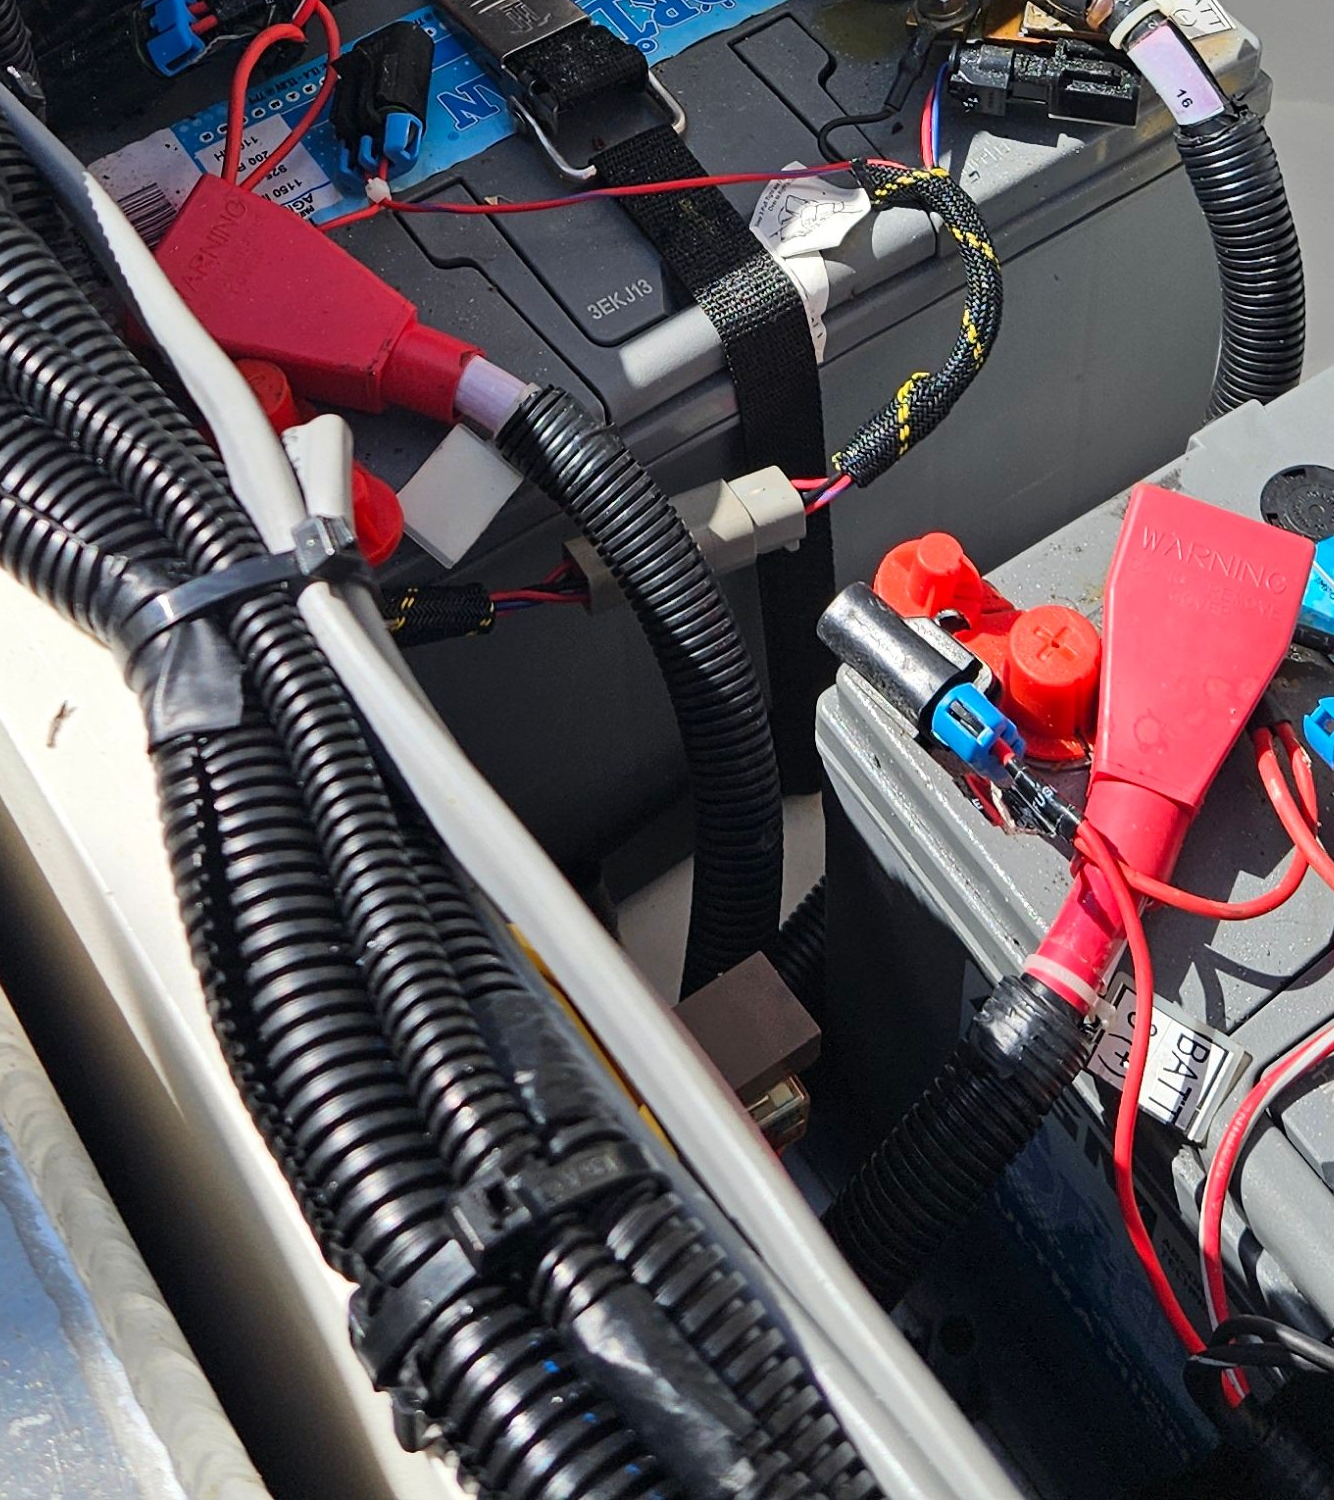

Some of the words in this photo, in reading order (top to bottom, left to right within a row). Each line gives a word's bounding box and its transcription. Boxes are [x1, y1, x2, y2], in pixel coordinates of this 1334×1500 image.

[1174, 86, 1194, 110] 16
[247, 149, 270, 166] 200
[271, 176, 303, 198] 1150
[586, 278, 653, 320] 3EKJ13
[1141, 525, 1288, 595] WARNING
[1149, 1032, 1212, 1125] BATT
